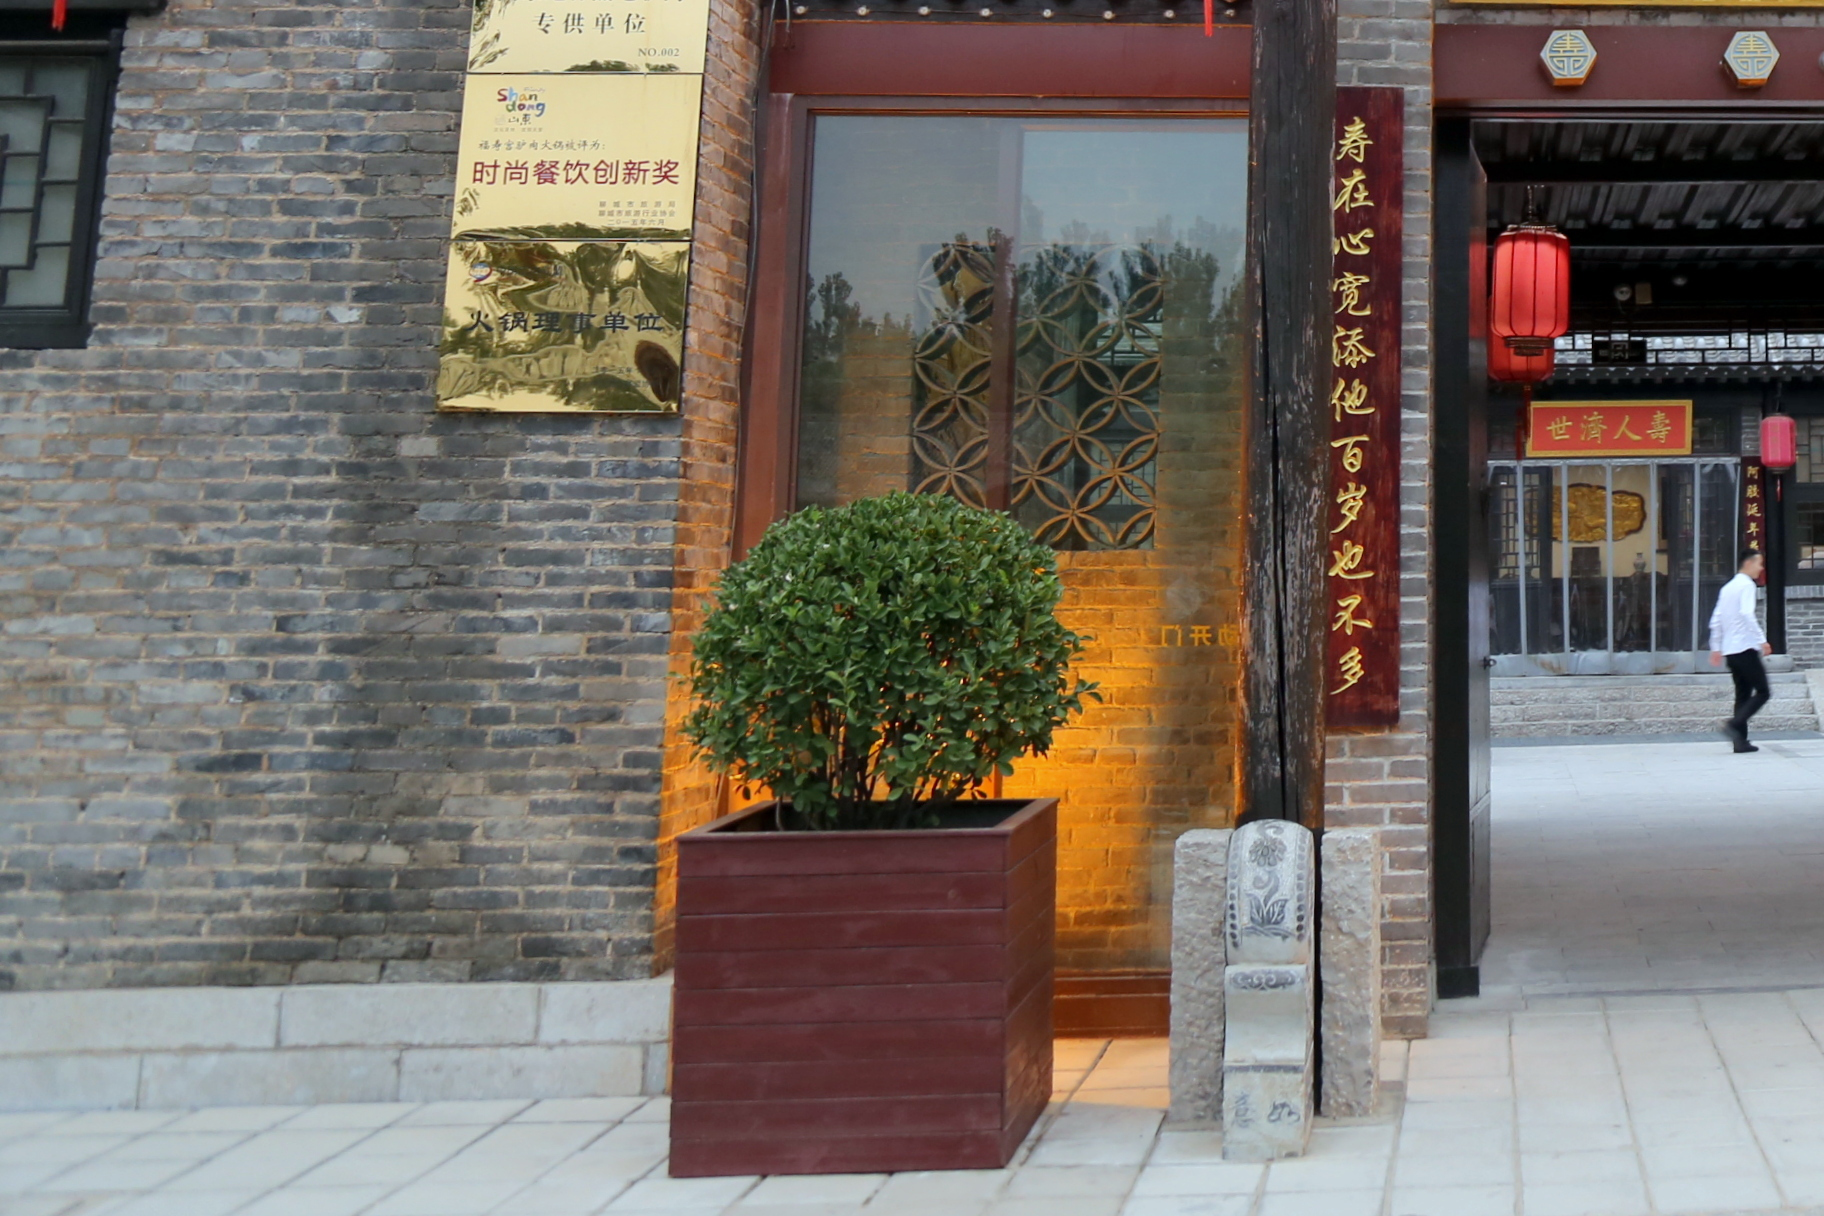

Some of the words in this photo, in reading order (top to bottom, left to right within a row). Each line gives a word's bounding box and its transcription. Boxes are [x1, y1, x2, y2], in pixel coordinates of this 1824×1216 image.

[532, 12, 646, 35] 专供单位
[638, 47, 680, 57] NO.002
[472, 159, 680, 185] 时尚餐饮创新奖
[464, 310, 665, 334] 火锅理事单位
